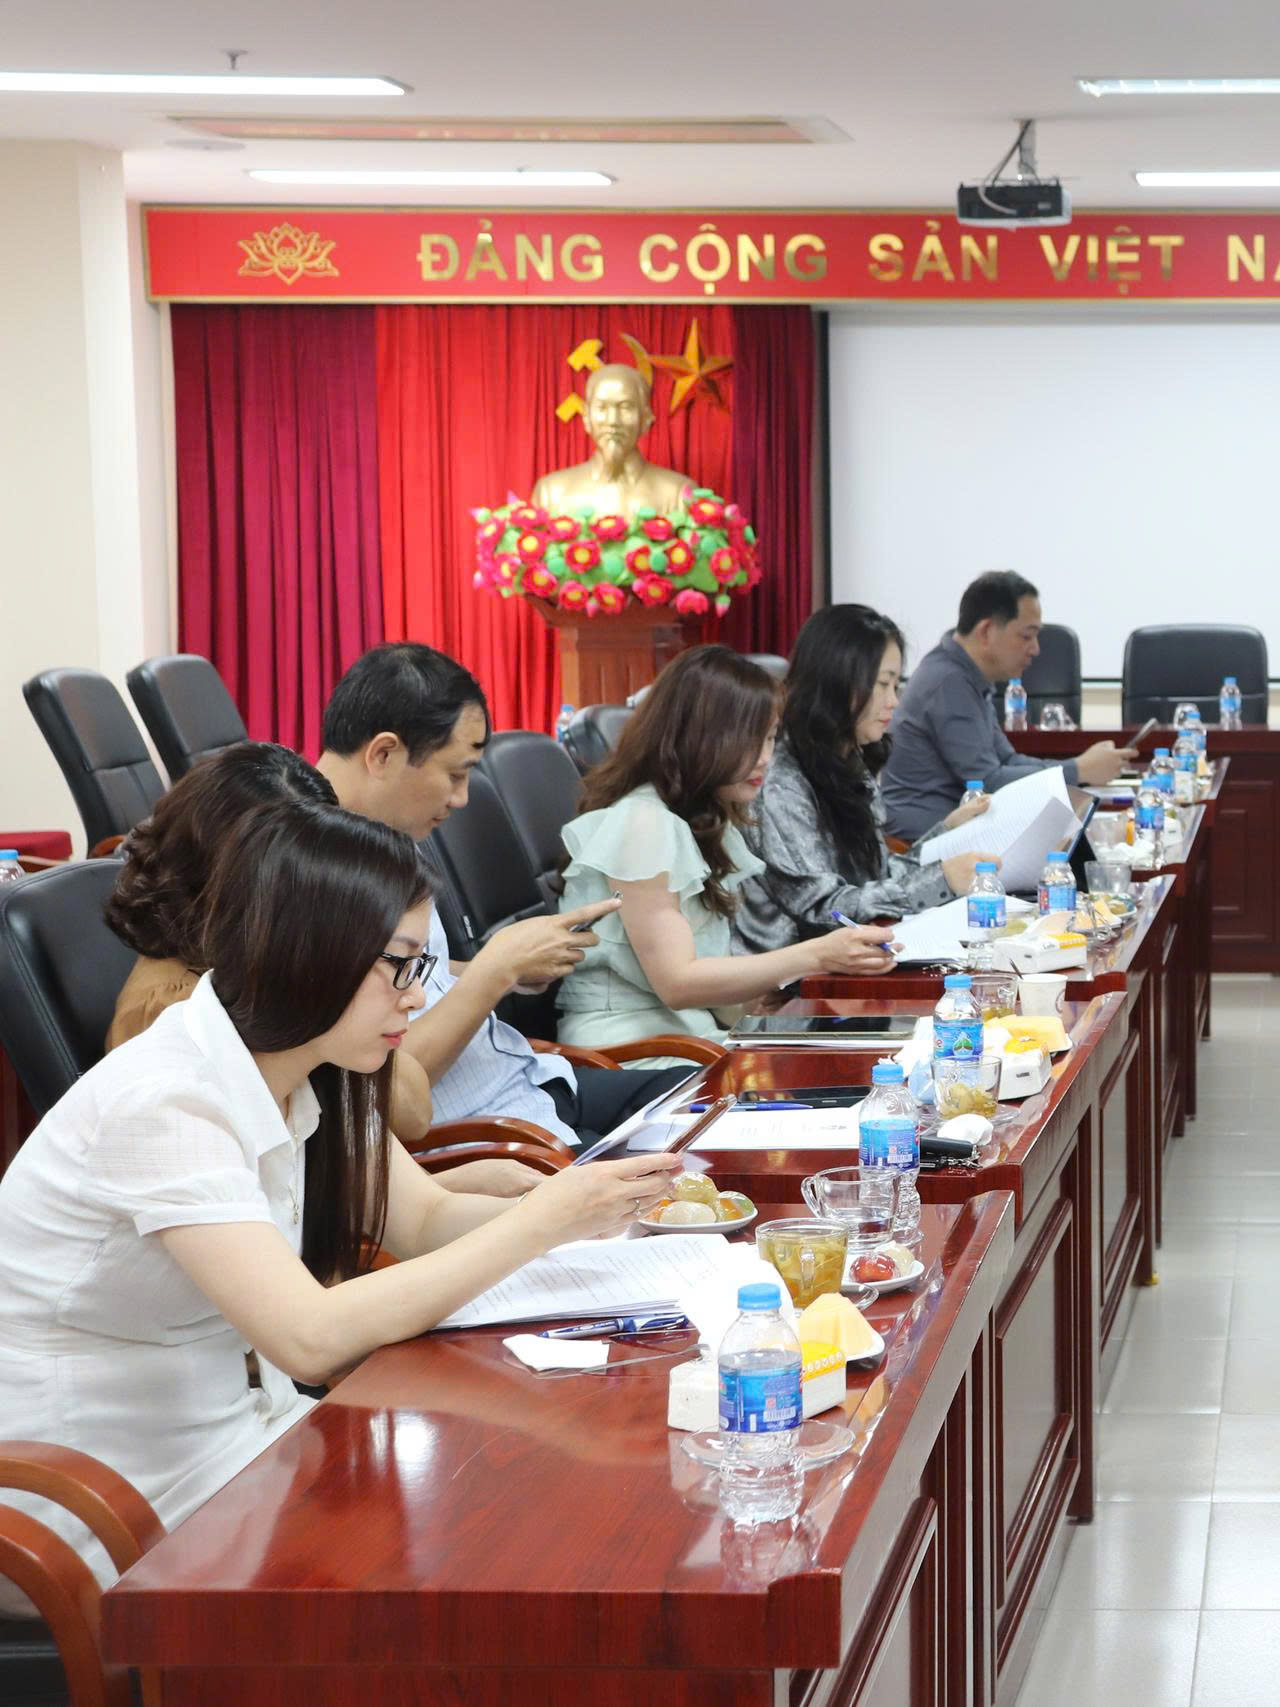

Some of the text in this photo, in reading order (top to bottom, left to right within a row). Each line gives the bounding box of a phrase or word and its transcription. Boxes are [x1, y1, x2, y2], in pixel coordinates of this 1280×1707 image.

[416, 218, 605, 283] ĐẢNG
[639, 222, 828, 295] CỘNG
[868, 219, 999, 283] SẢN
[1038, 226, 1186, 296] VIỆT
